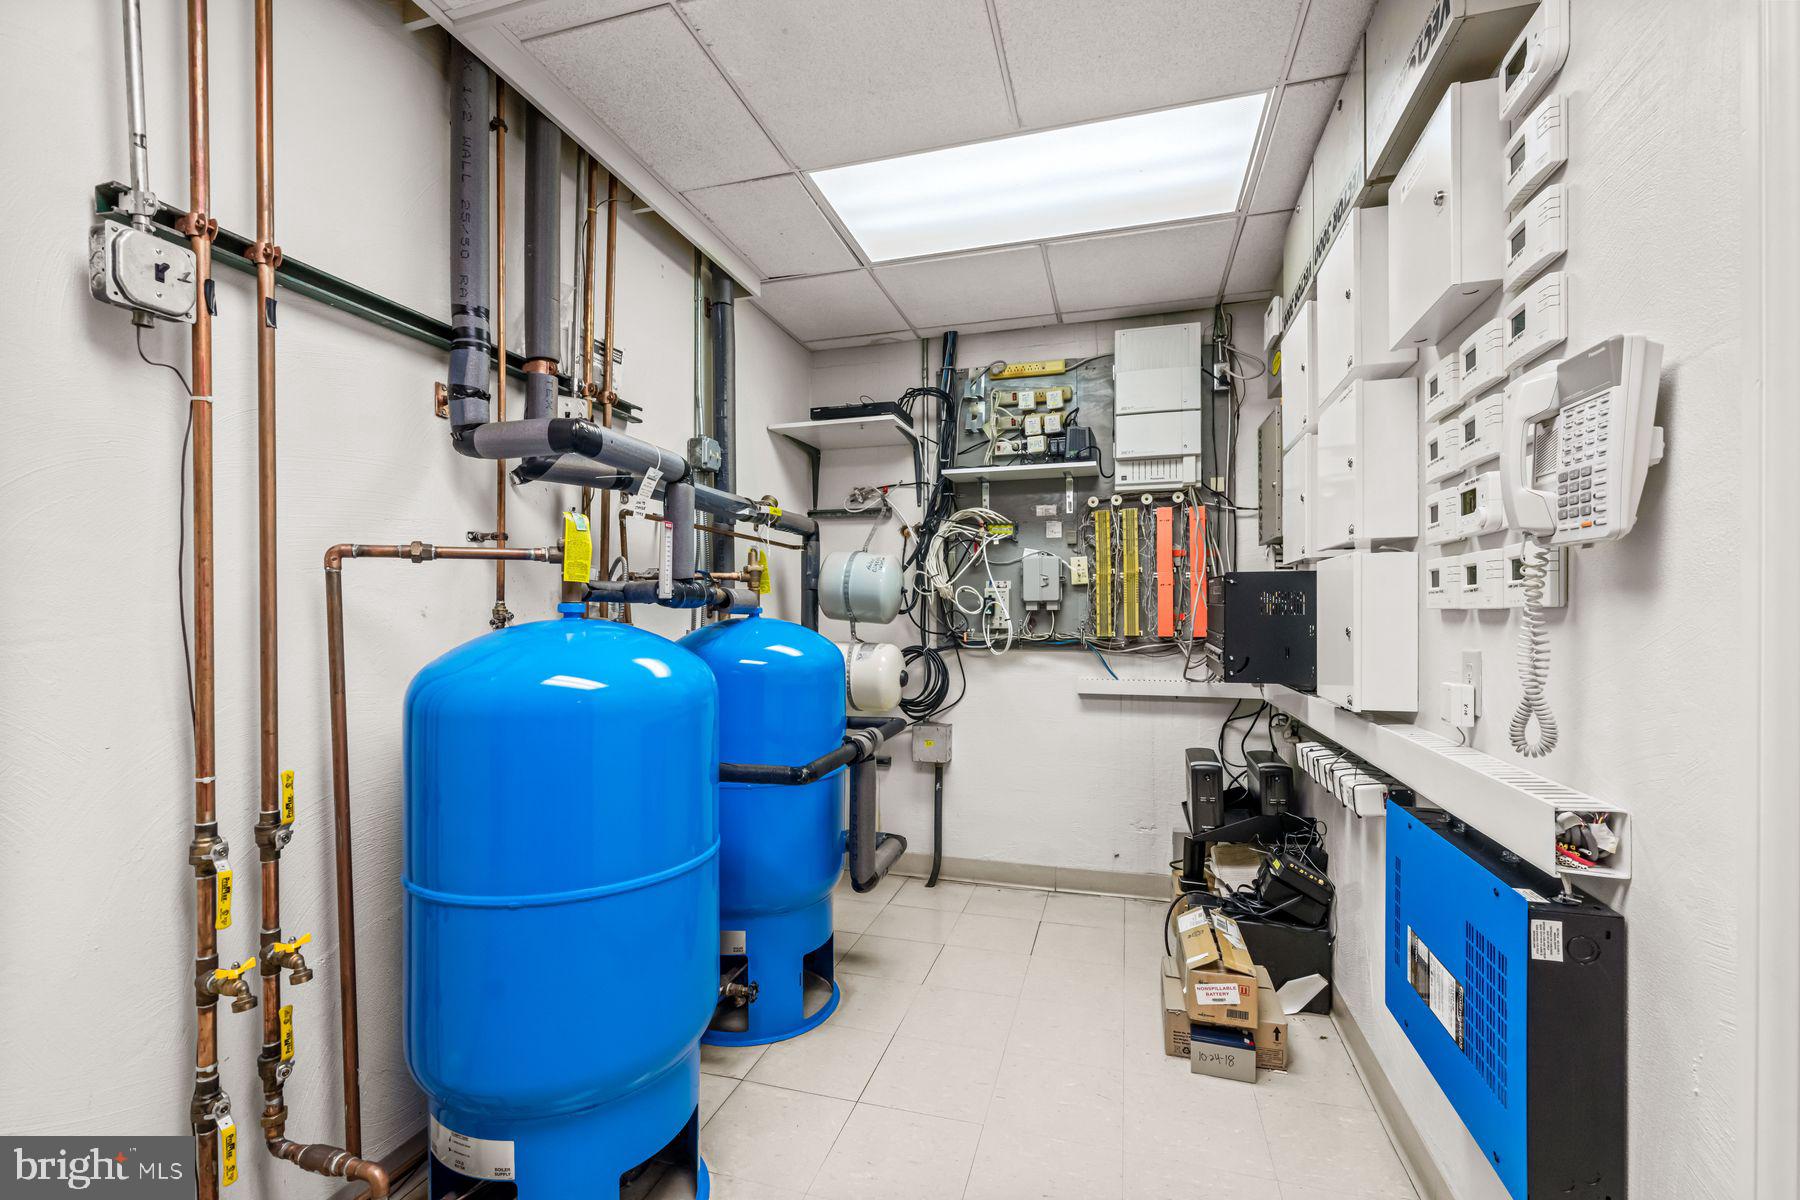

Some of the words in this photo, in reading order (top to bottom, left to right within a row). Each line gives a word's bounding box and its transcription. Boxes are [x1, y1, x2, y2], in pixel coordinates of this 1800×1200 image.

[461, 85, 472, 123] 1/2
[461, 135, 472, 183] WALL
[460, 198, 471, 259] 25/50
